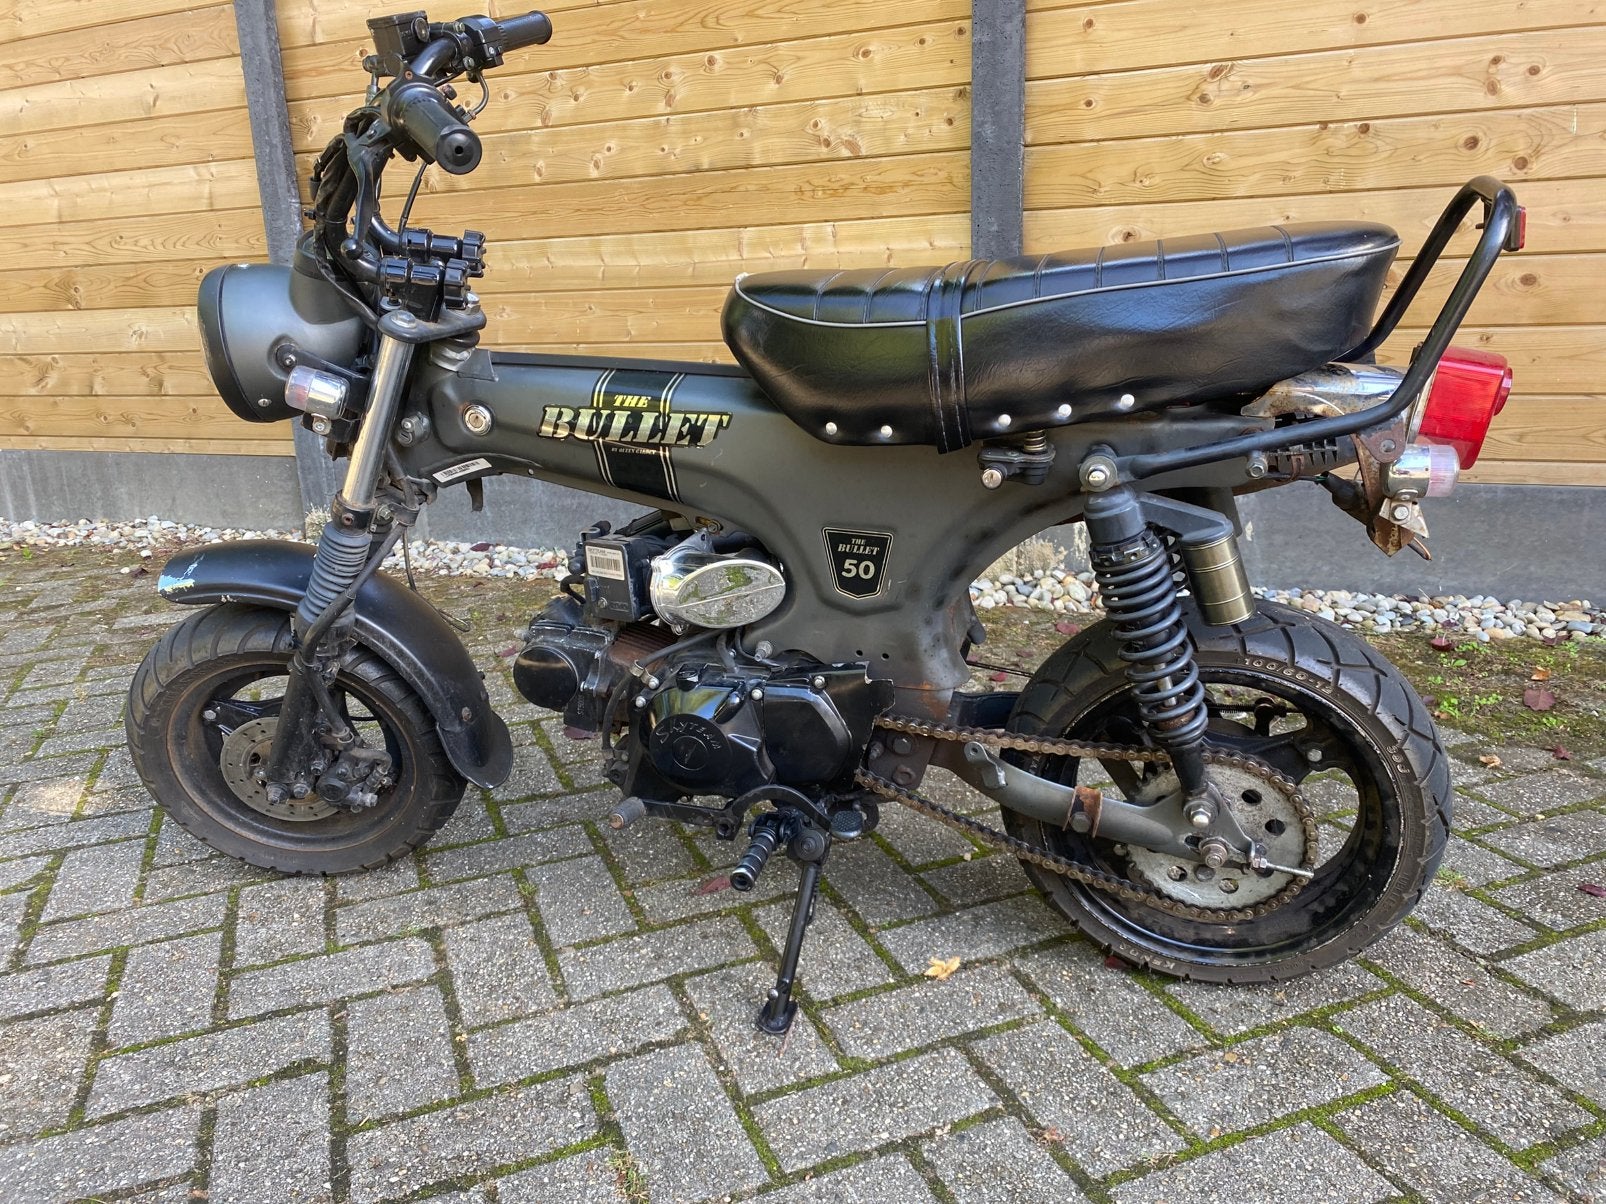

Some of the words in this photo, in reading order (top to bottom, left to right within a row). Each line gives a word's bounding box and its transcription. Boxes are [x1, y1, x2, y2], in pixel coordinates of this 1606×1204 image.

[613, 394, 652, 408] THE
[538, 404, 732, 447] BULLET
[837, 543, 880, 555] BULLET
[841, 558, 876, 580] 50
